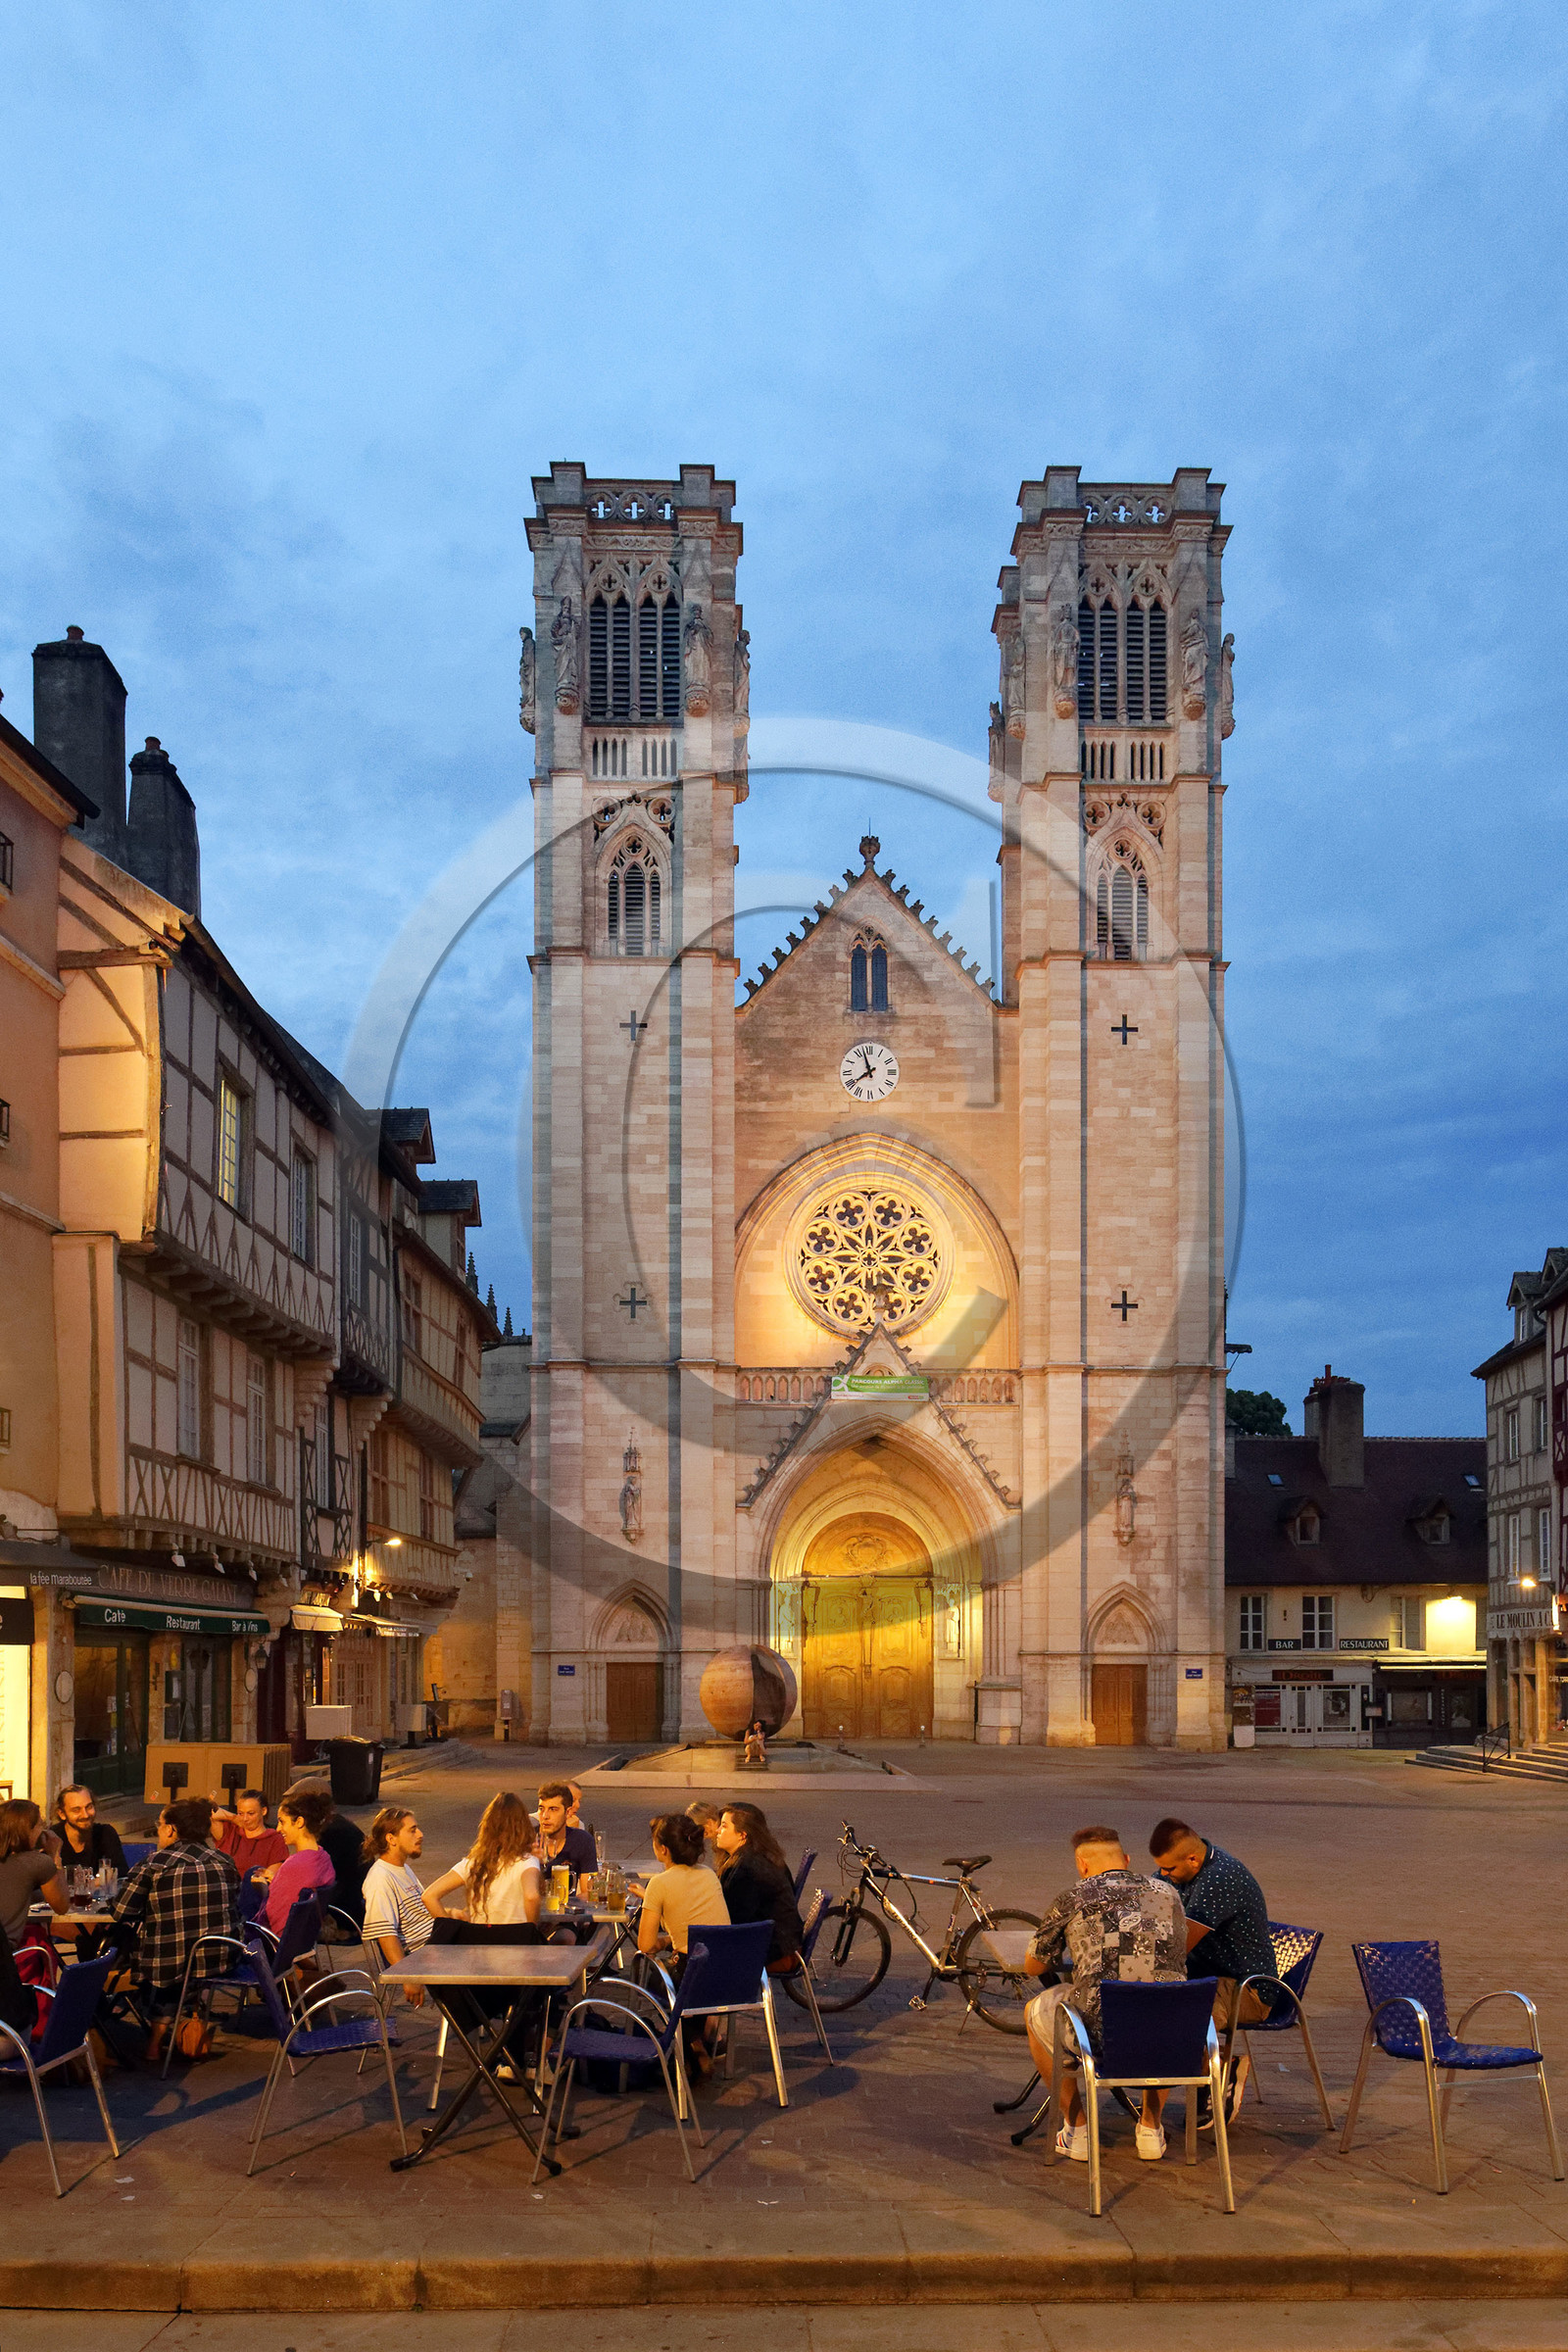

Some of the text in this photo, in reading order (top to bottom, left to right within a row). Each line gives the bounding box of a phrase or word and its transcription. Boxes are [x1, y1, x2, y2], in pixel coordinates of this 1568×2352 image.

[166, 1615, 201, 1631] Restaurant
[231, 1620, 242, 1633] Bar
[1496, 1614, 1505, 1629] LE
[1507, 1612, 1536, 1628] MOULIN
[1275, 1641, 1295, 1649] BAR
[1340, 1640, 1389, 1649] RESTAURANT
